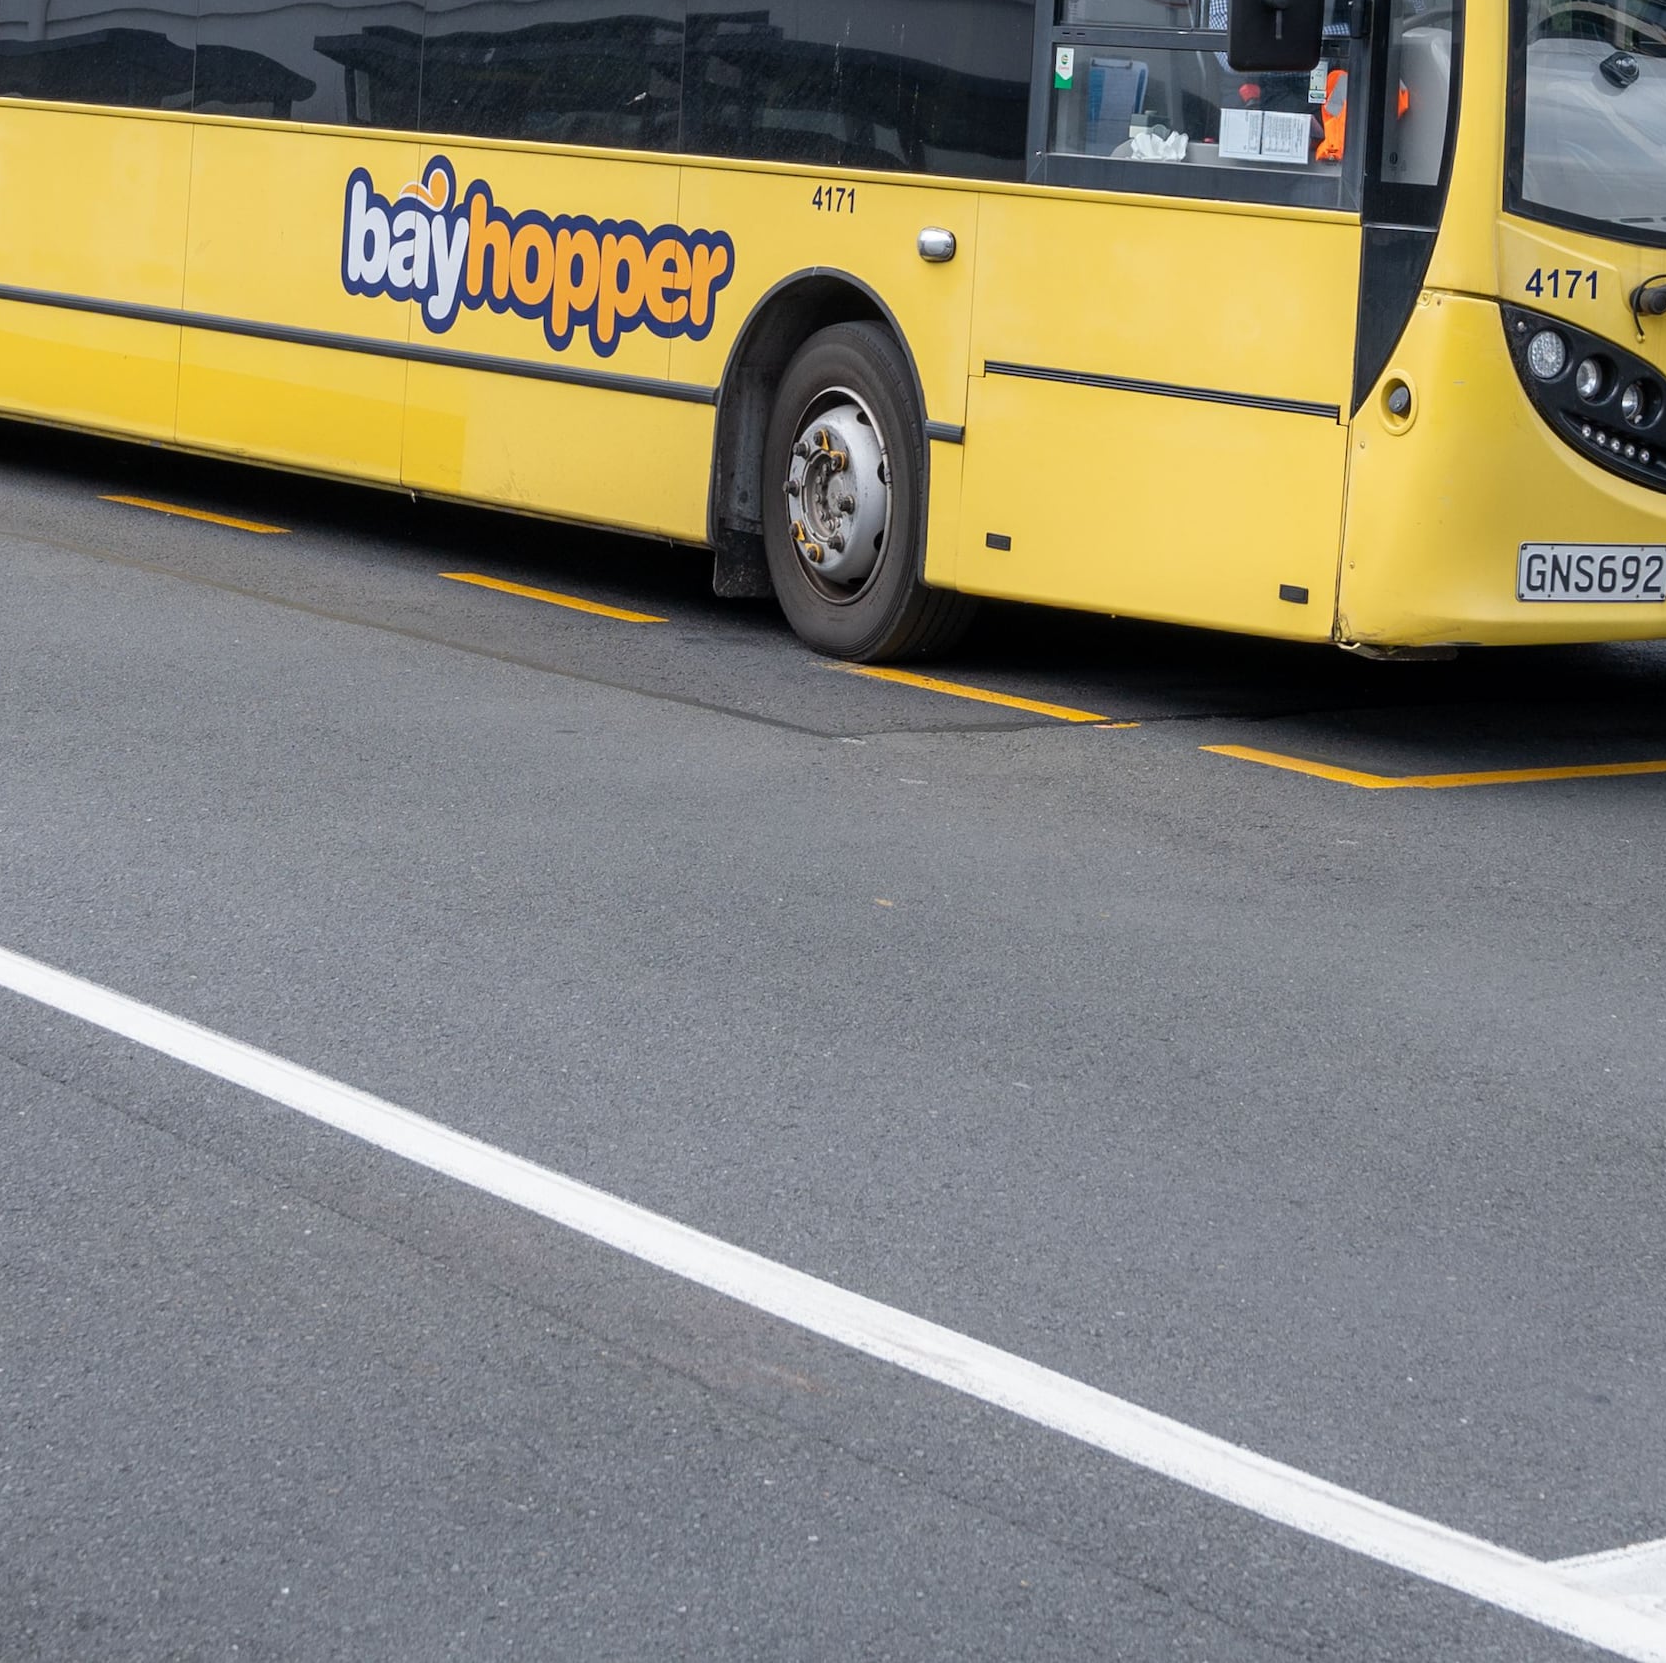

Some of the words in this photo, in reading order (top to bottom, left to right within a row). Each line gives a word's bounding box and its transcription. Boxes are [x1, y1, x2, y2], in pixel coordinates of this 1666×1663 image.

[812, 185, 855, 214] 4171
[345, 178, 730, 346] bayhopper
[1525, 268, 1598, 300] 4171
[1525, 553, 1665, 593] GNS692
